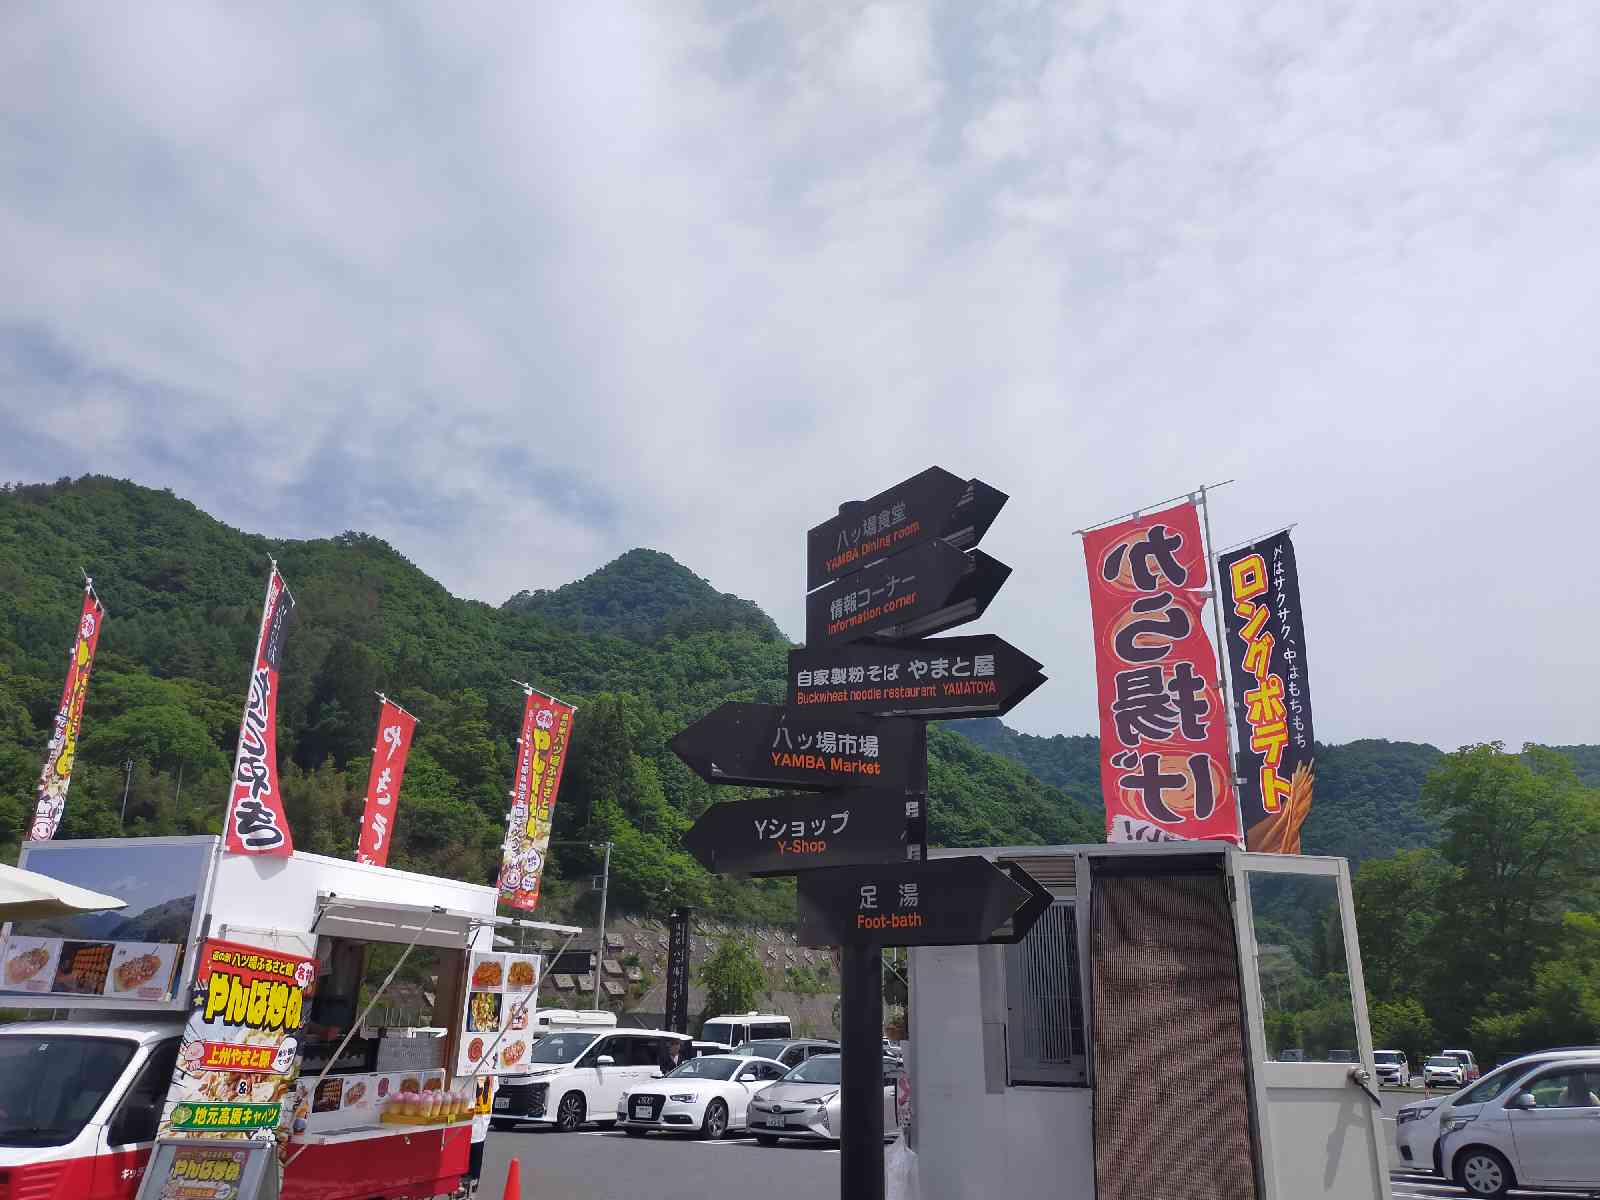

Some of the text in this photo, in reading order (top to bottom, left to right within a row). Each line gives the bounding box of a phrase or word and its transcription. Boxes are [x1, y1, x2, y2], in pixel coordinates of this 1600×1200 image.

[824, 519, 920, 573] YAMBA Dining room
[827, 592, 917, 636] Information corner
[830, 576, 916, 621] 情報コーナー
[797, 655, 995, 687] 自家製粉そば やまと屋
[1229, 554, 1294, 813] ロングポテト
[797, 680, 997, 705] Buckwheat noodle restaurant YAMATOYA
[771, 727, 879, 758] 八ッ場市場
[771, 752, 881, 775] YAMBA Market
[754, 810, 851, 841] Yショップ
[777, 840, 826, 855] Y-Shop
[857, 914, 922, 930] Foot-bath
[238, 1081, 247, 1095] &
